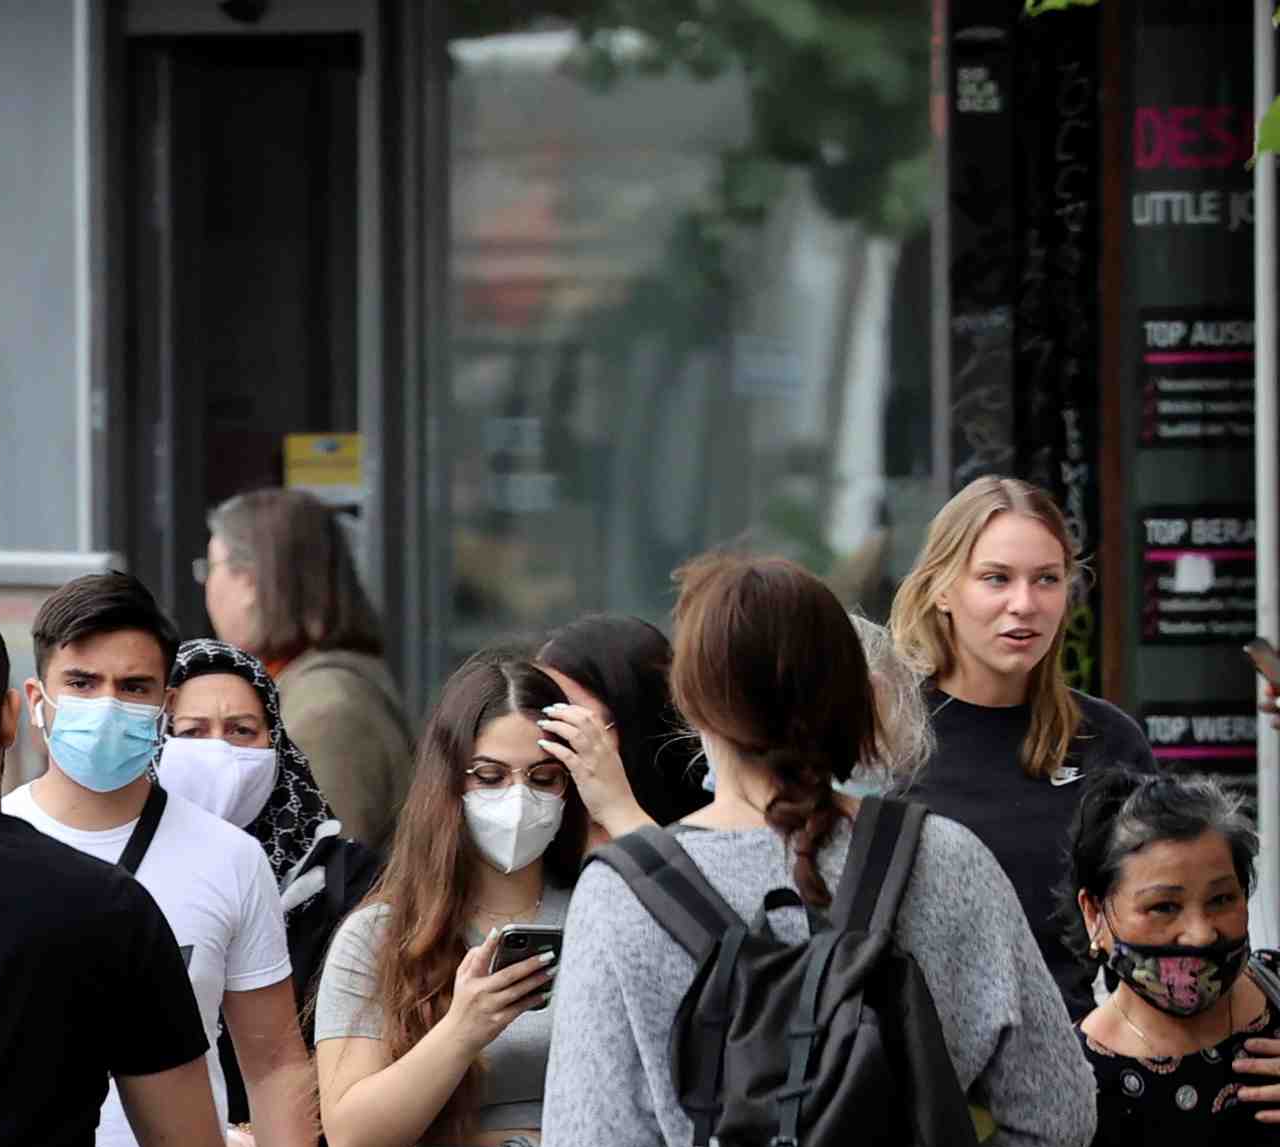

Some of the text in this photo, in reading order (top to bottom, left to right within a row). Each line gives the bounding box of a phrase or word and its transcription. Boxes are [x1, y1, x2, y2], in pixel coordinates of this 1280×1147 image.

[1143, 320, 1187, 347] TOP
[1144, 518, 1188, 544] TOP
[1144, 715, 1189, 743] TOP
